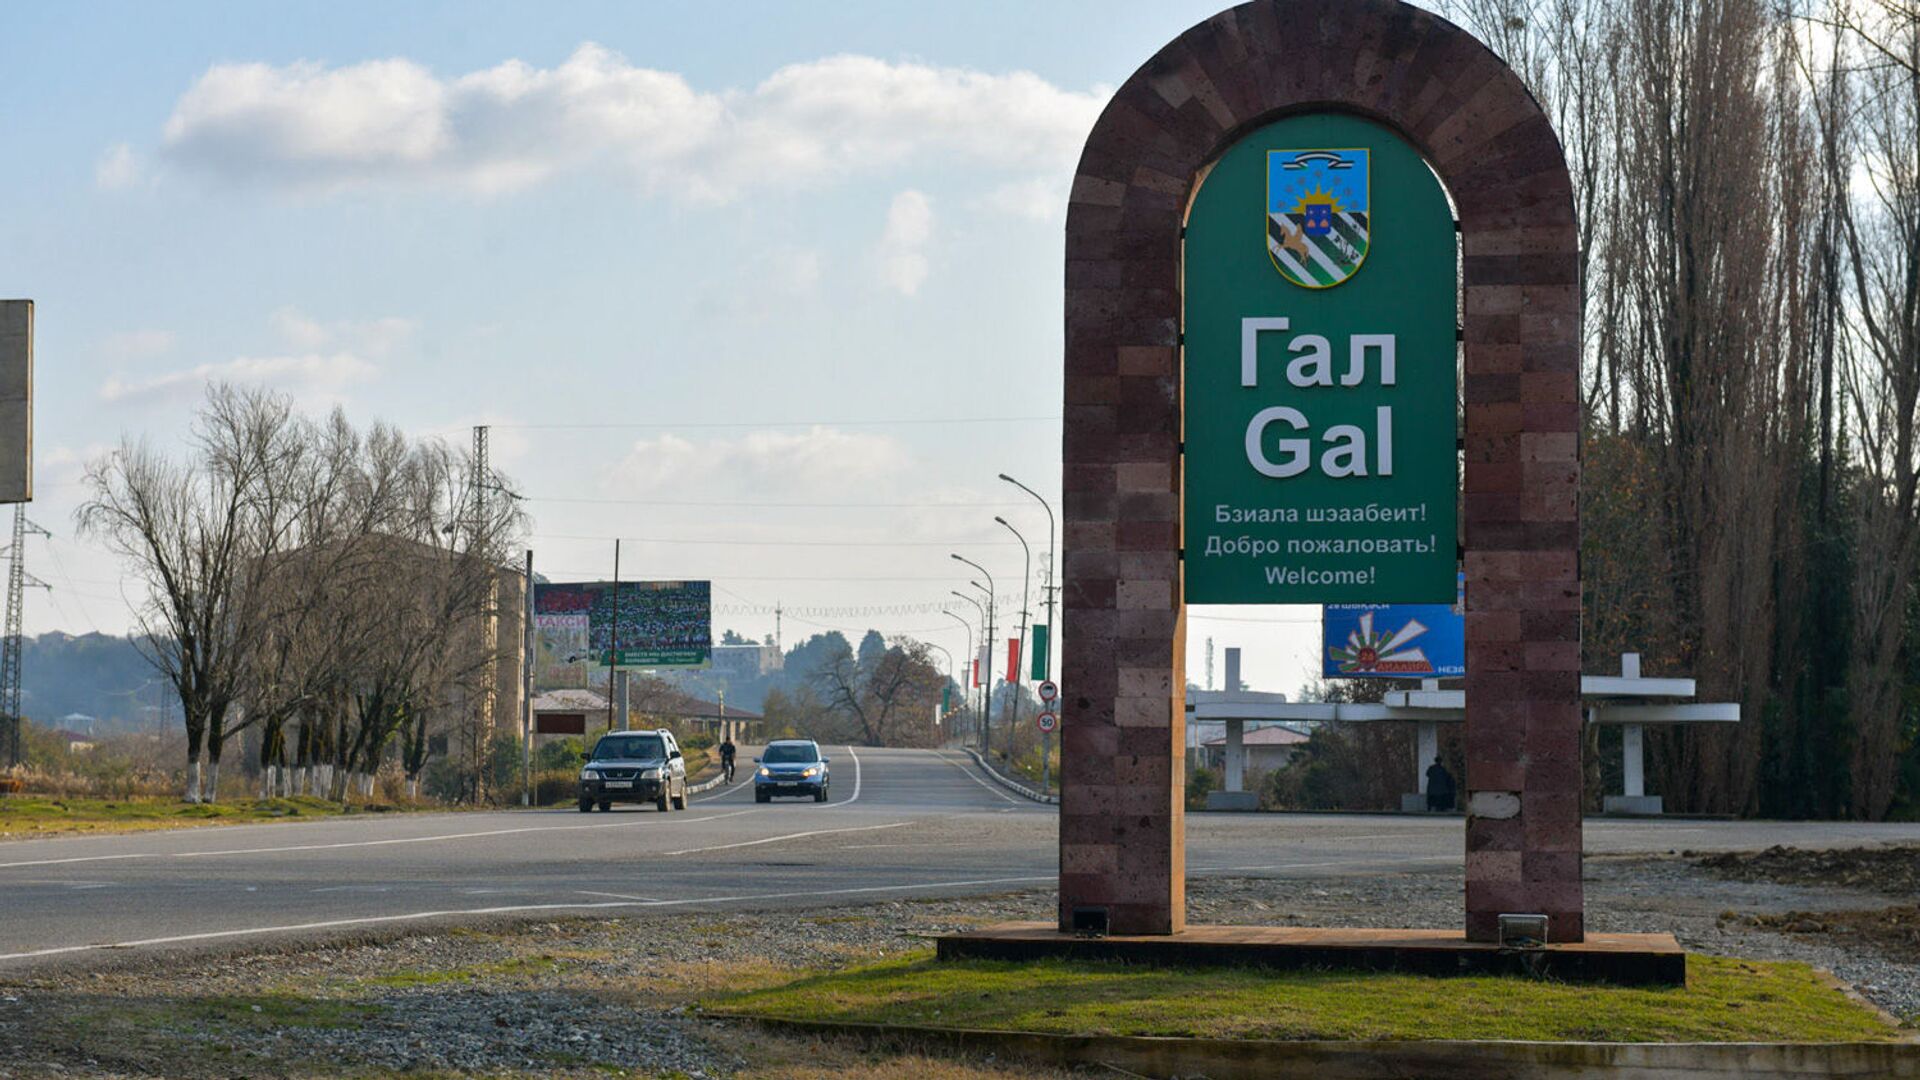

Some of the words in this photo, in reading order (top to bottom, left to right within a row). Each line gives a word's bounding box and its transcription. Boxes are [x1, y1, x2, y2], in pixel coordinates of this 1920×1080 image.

[1241, 317, 1396, 387] Гал
[1245, 405, 1393, 478] Gal
[1215, 504, 1299, 523] Бзиала
[1306, 503, 1427, 522] шэаабеит!
[1204, 535, 1280, 558] Добро
[1287, 534, 1436, 554] пожаловать!
[1265, 566, 1375, 585] Welcome!
[536, 615, 587, 626] ТАКСИ
[1042, 718, 1052, 726] 50
